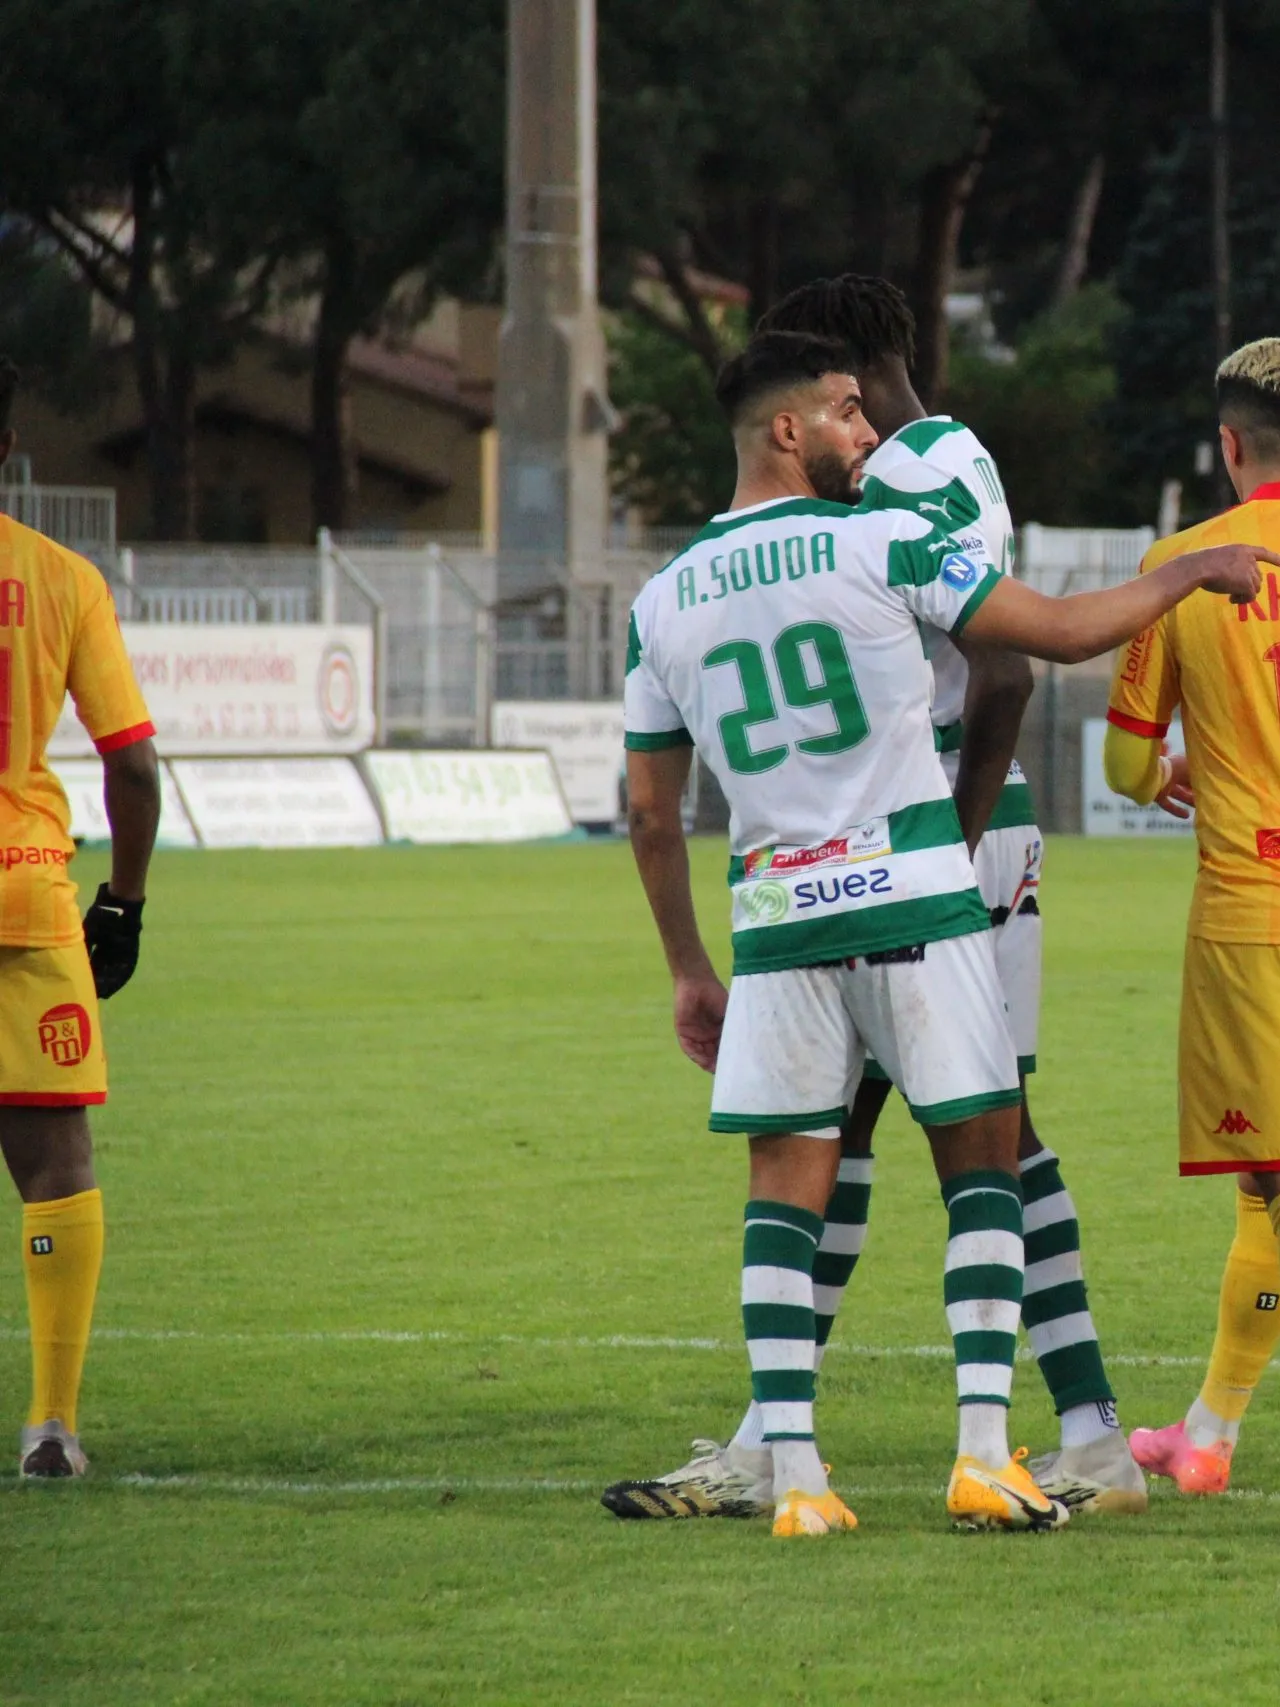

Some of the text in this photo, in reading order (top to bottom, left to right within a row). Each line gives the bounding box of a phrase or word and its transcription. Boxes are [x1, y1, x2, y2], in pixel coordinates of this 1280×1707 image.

[946, 557, 971, 581] N
[701, 619, 872, 776] 29
[794, 868, 893, 909] suez
[33, 1237, 50, 1252] 11
[1259, 1294, 1278, 1309] 13
